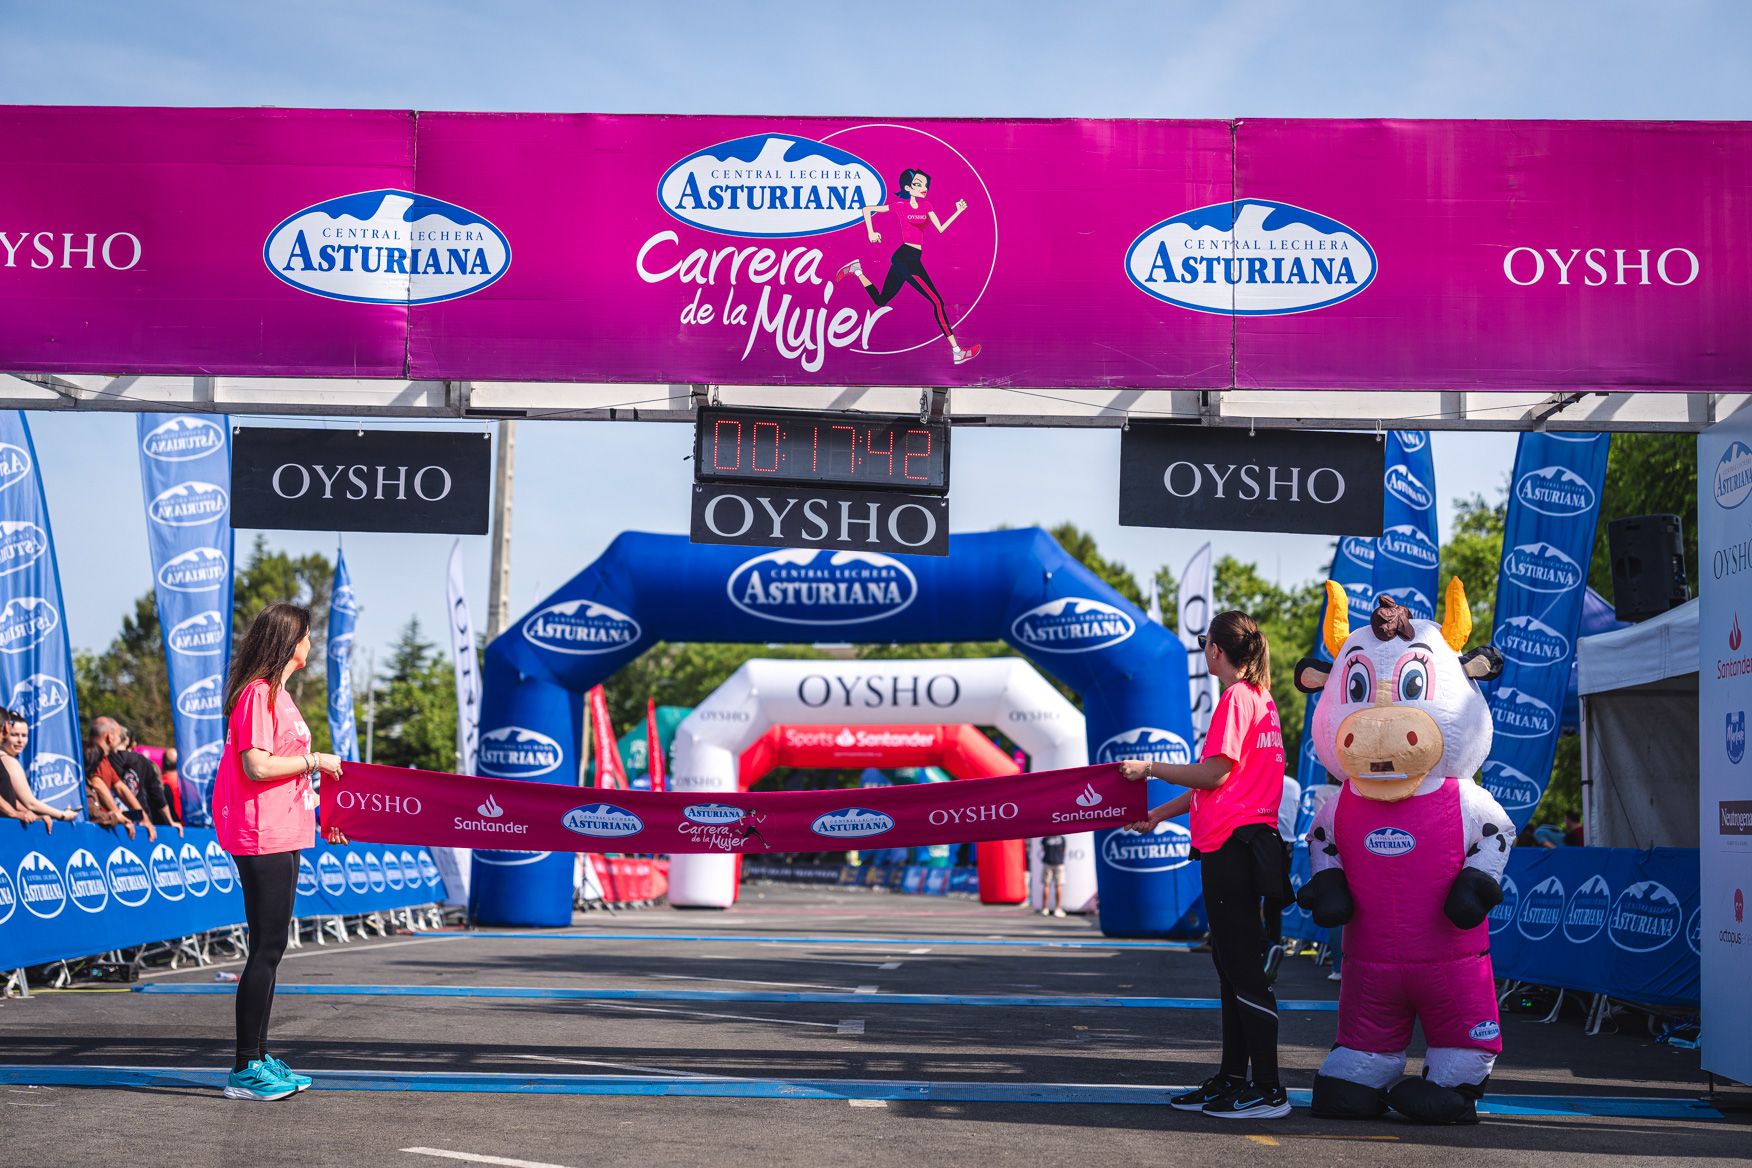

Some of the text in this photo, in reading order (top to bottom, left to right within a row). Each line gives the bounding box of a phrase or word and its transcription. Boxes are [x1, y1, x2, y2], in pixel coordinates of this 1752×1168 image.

[711, 169, 861, 180] CENTRAL LECHERA
[675, 171, 868, 211] ASTURIANA
[322, 227, 401, 240] CENTRAL
[1184, 239, 1349, 250] CENTRAL LECHERA
[282, 229, 491, 275] ASTURIANA
[636, 230, 824, 285] Carrera
[1144, 240, 1358, 284] ASTURIANA
[1503, 246, 1700, 286] OYSHO
[680, 281, 893, 372] de la Mujer
[713, 420, 931, 481] 00:17:42
[272, 463, 452, 501] OYSHO
[1163, 461, 1346, 504] OYSHO
[1521, 480, 1586, 508] ASTURIANA
[704, 494, 937, 547] OYSHO
[742, 569, 903, 605] ASTURIANA
[530, 617, 631, 643] ASTURIANA
[1022, 621, 1127, 642] ASTURIANA
[797, 674, 961, 709] OYSHO
[786, 729, 935, 748] Sports Santander
[336, 790, 422, 815] OYSHO
[688, 808, 740, 818] ASTURIANA
[928, 802, 1018, 826] OYSHO
[1052, 806, 1127, 823] Santander
[454, 817, 529, 834] Santander
[568, 815, 638, 831] ASTURIANA
[678, 822, 729, 834] Carrera
[818, 820, 888, 832] ASTURIANA
[691, 834, 701, 842] de
[709, 833, 749, 851] Mujer
[1369, 837, 1412, 848] ASTURIANA
[1611, 902, 1674, 937] ASTURIANA
